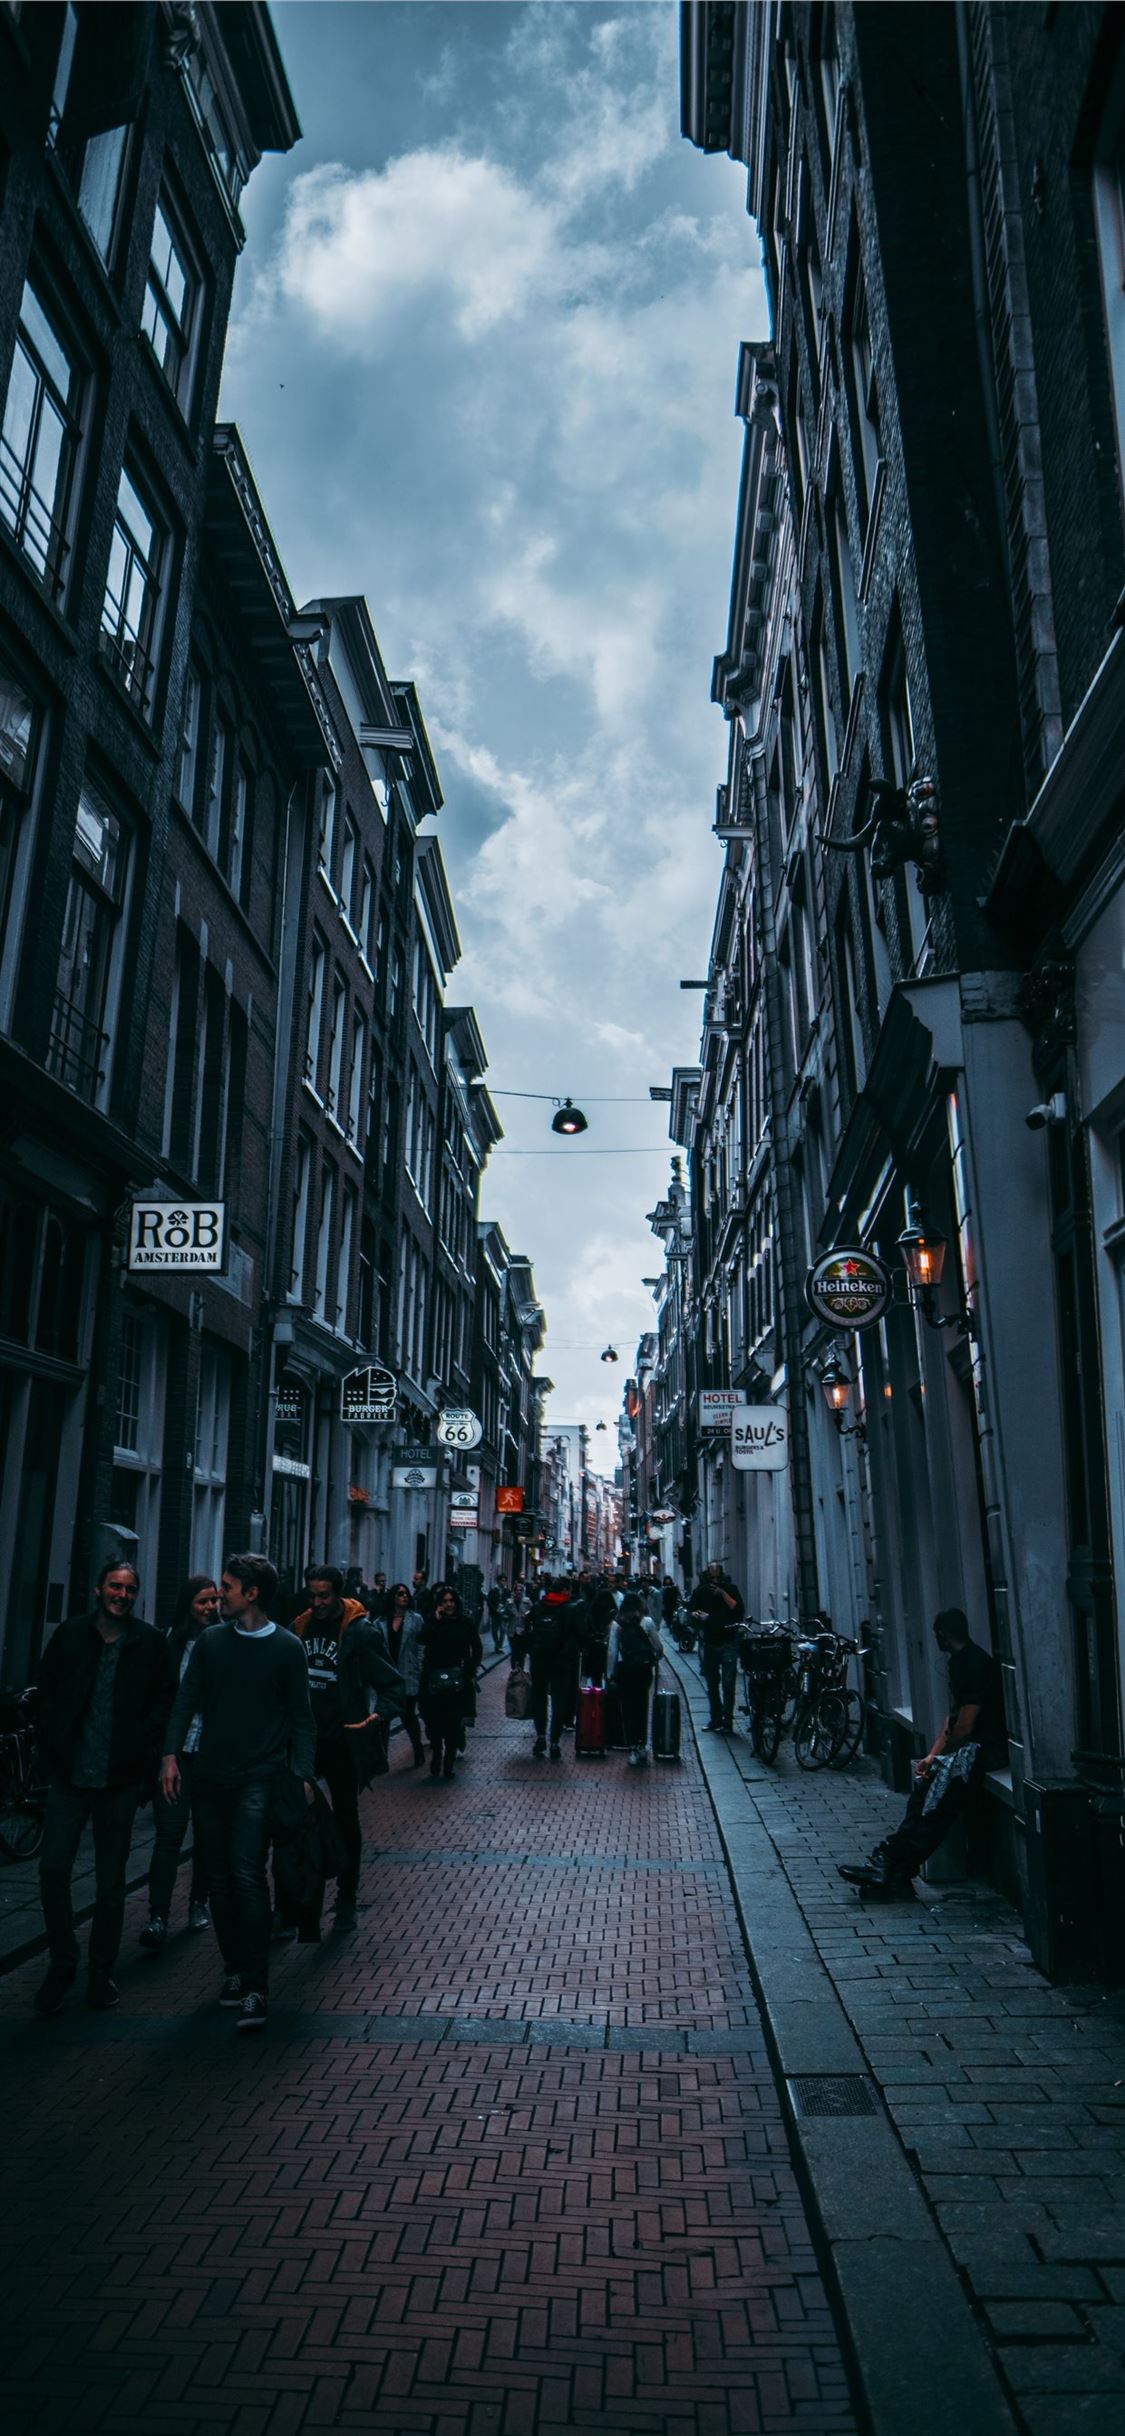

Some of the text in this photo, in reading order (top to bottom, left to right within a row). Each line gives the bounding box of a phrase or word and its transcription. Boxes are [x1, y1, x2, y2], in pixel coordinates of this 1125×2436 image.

[134, 1252, 216, 1263] AMSTERDAM
[817, 1280, 882, 1293] Heineken
[703, 1394, 743, 1403] HOTEL
[349, 1405, 388, 1413] BURGER
[446, 1426, 467, 1441] 66
[735, 1421, 785, 1446] SAUL'S
[401, 1448, 432, 1459] HOTEL
